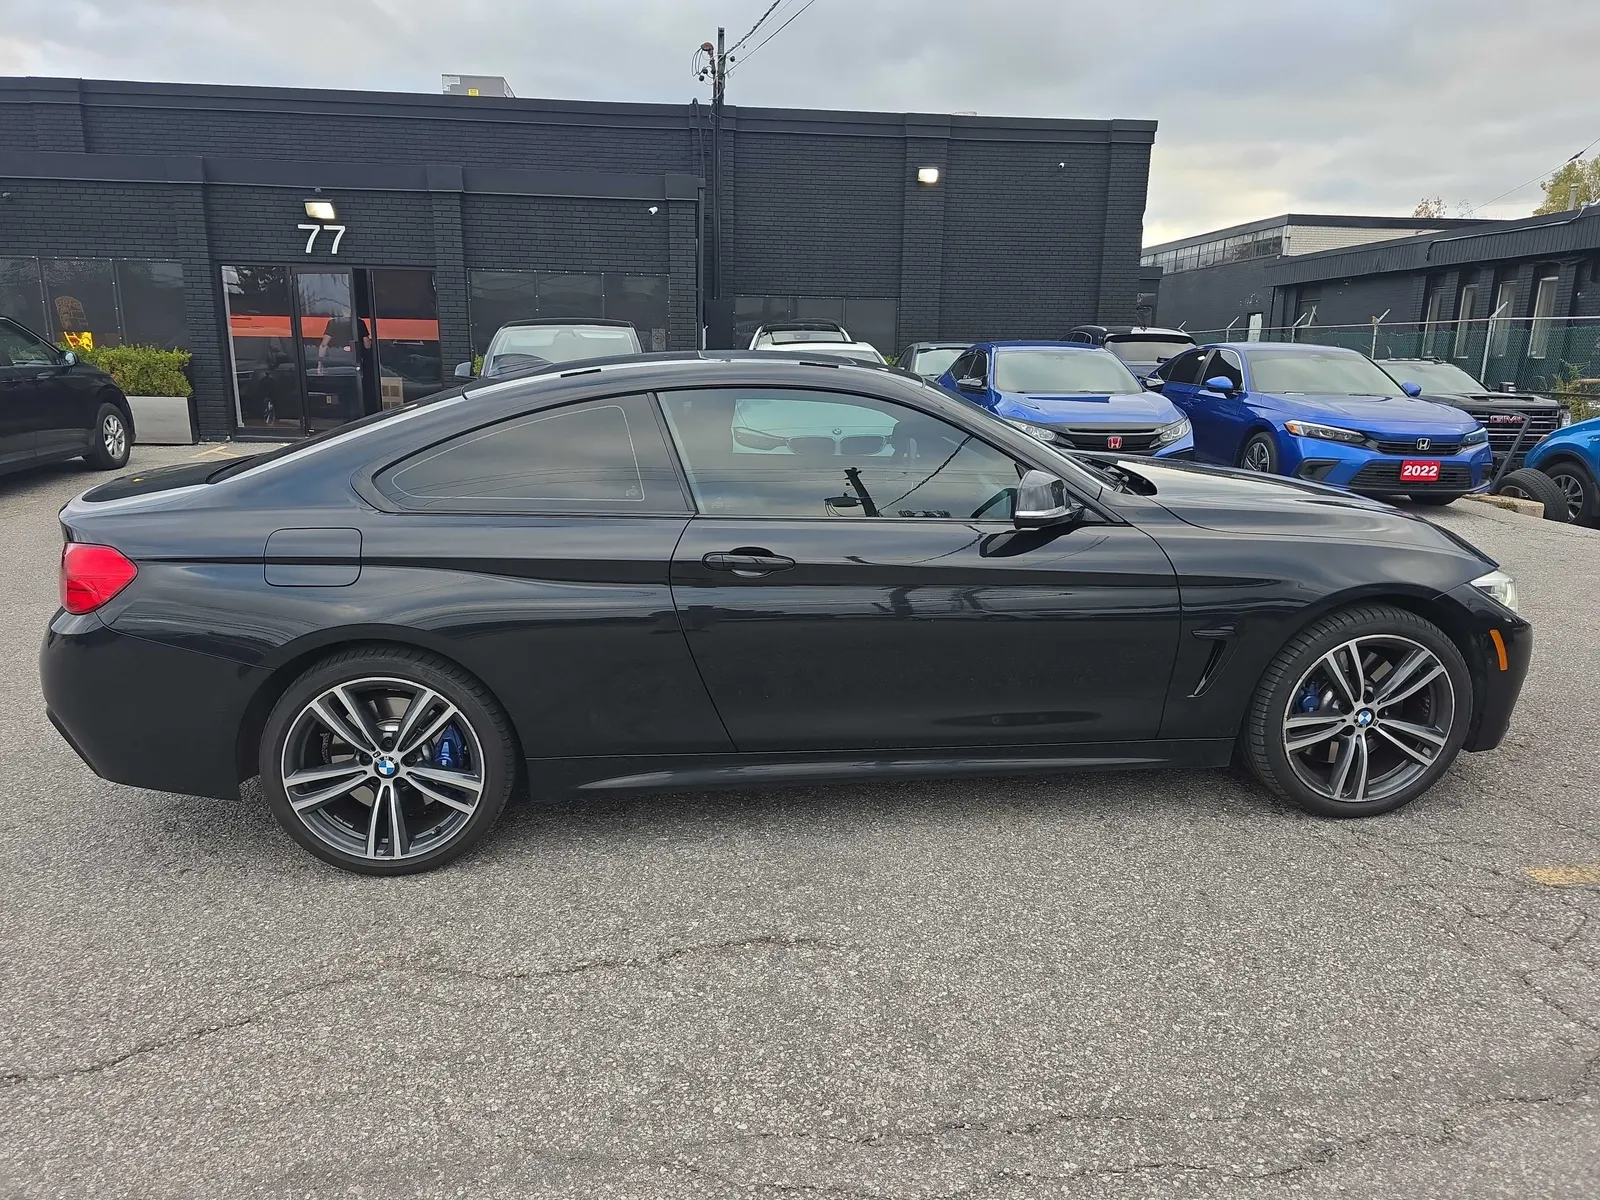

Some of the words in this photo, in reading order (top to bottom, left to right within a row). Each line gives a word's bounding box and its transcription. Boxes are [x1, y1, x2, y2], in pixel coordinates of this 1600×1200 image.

[297, 223, 346, 254] 77
[1490, 415, 1523, 424] GM
[1403, 465, 1438, 476] 2022
